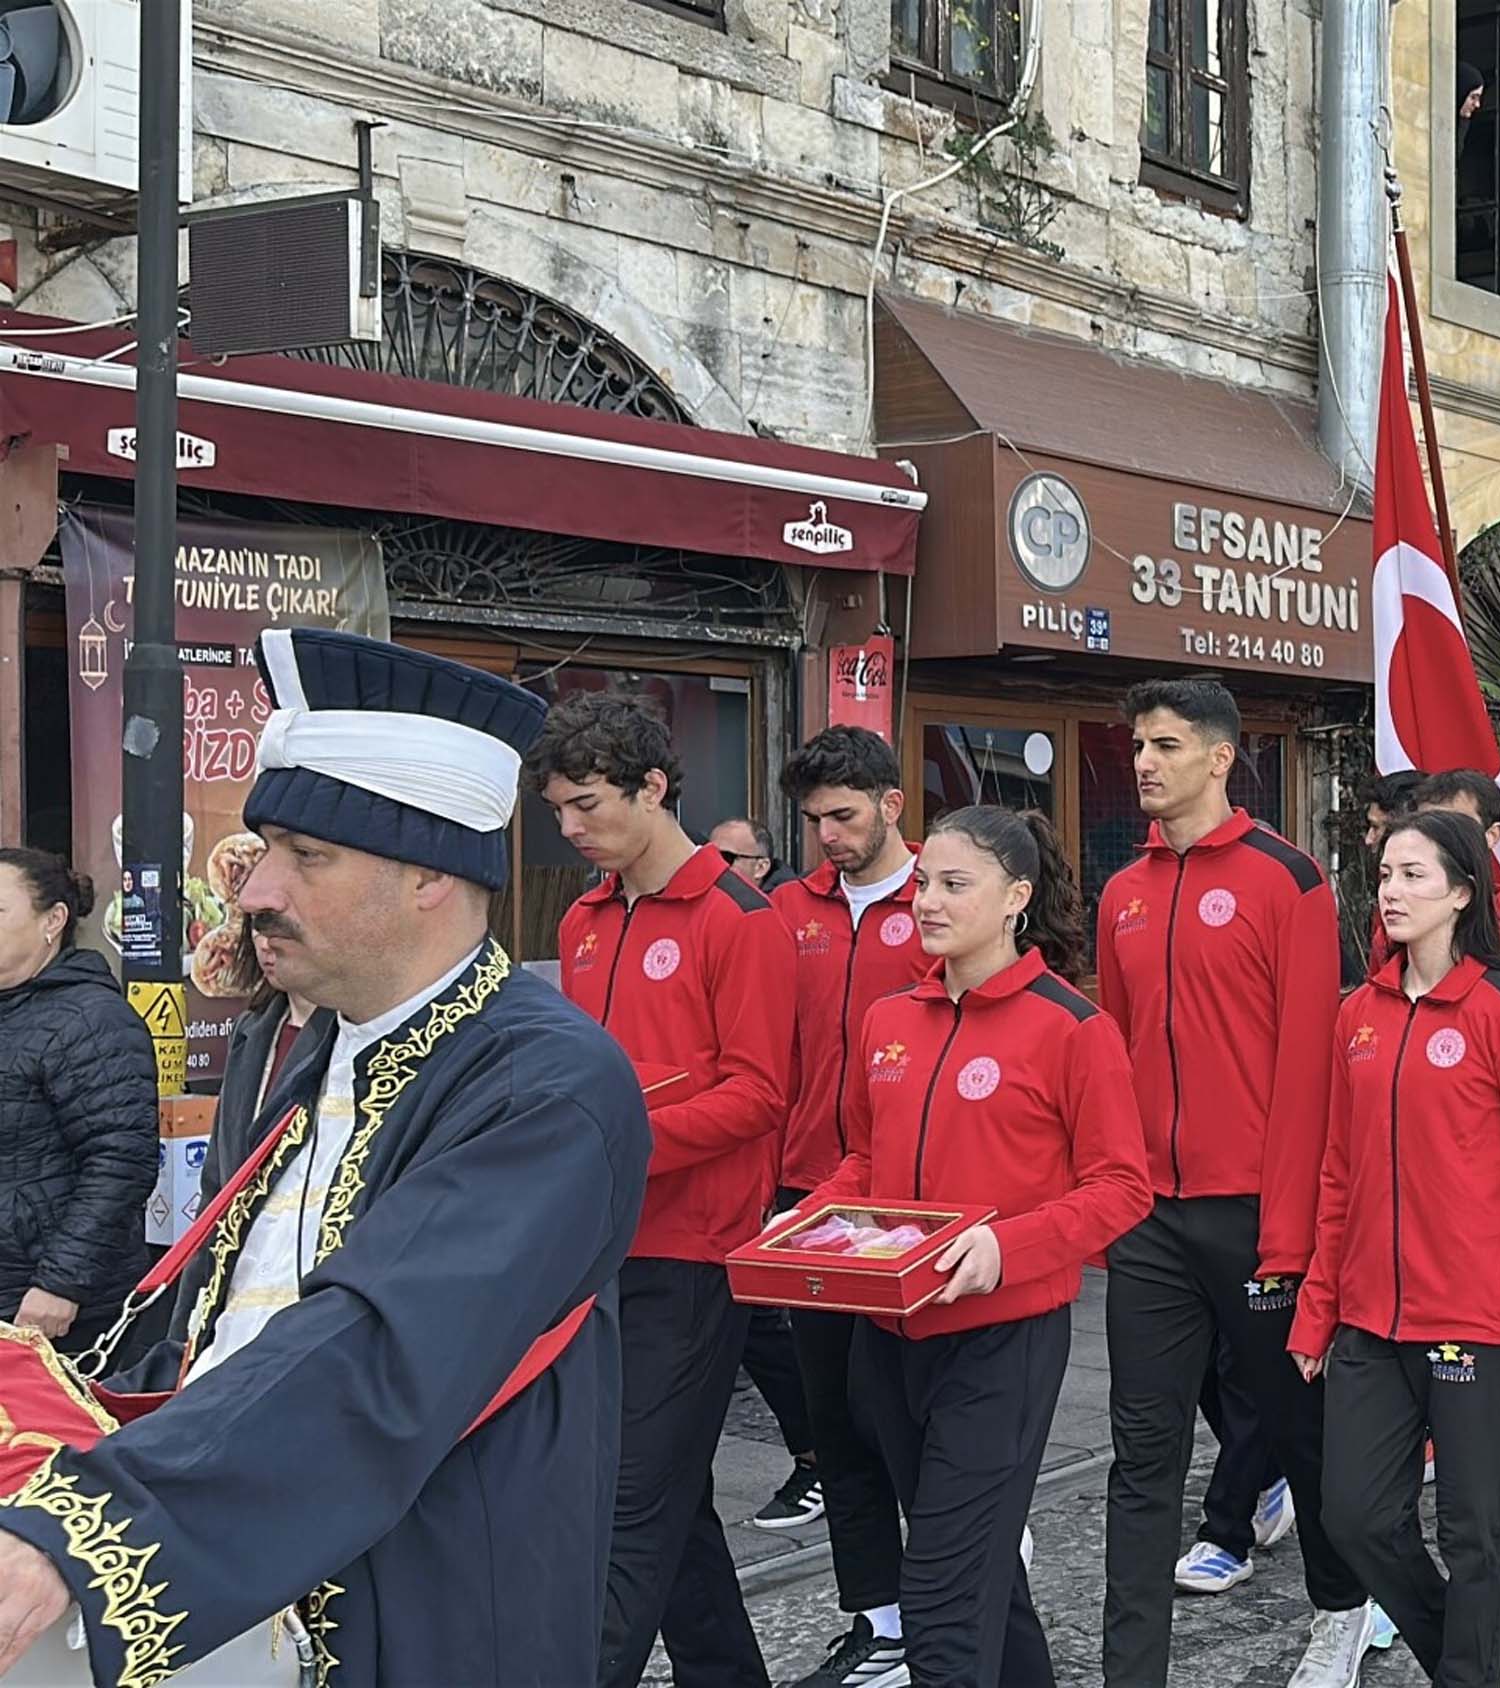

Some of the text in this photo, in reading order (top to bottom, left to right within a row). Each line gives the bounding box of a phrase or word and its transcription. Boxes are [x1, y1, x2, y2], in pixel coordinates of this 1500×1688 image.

[791, 527, 845, 548] şenpiliç
[1022, 505, 1080, 559] CP
[1173, 502, 1324, 572] EFSANE
[275, 554, 321, 581] TADI
[123, 576, 338, 621] TTUNİYLE ÇIKAR!
[1131, 554, 1358, 632] 33 TANTUNİ
[1023, 601, 1084, 640] PİLİÇ
[1181, 627, 1324, 668] Tel: 214 40 80
